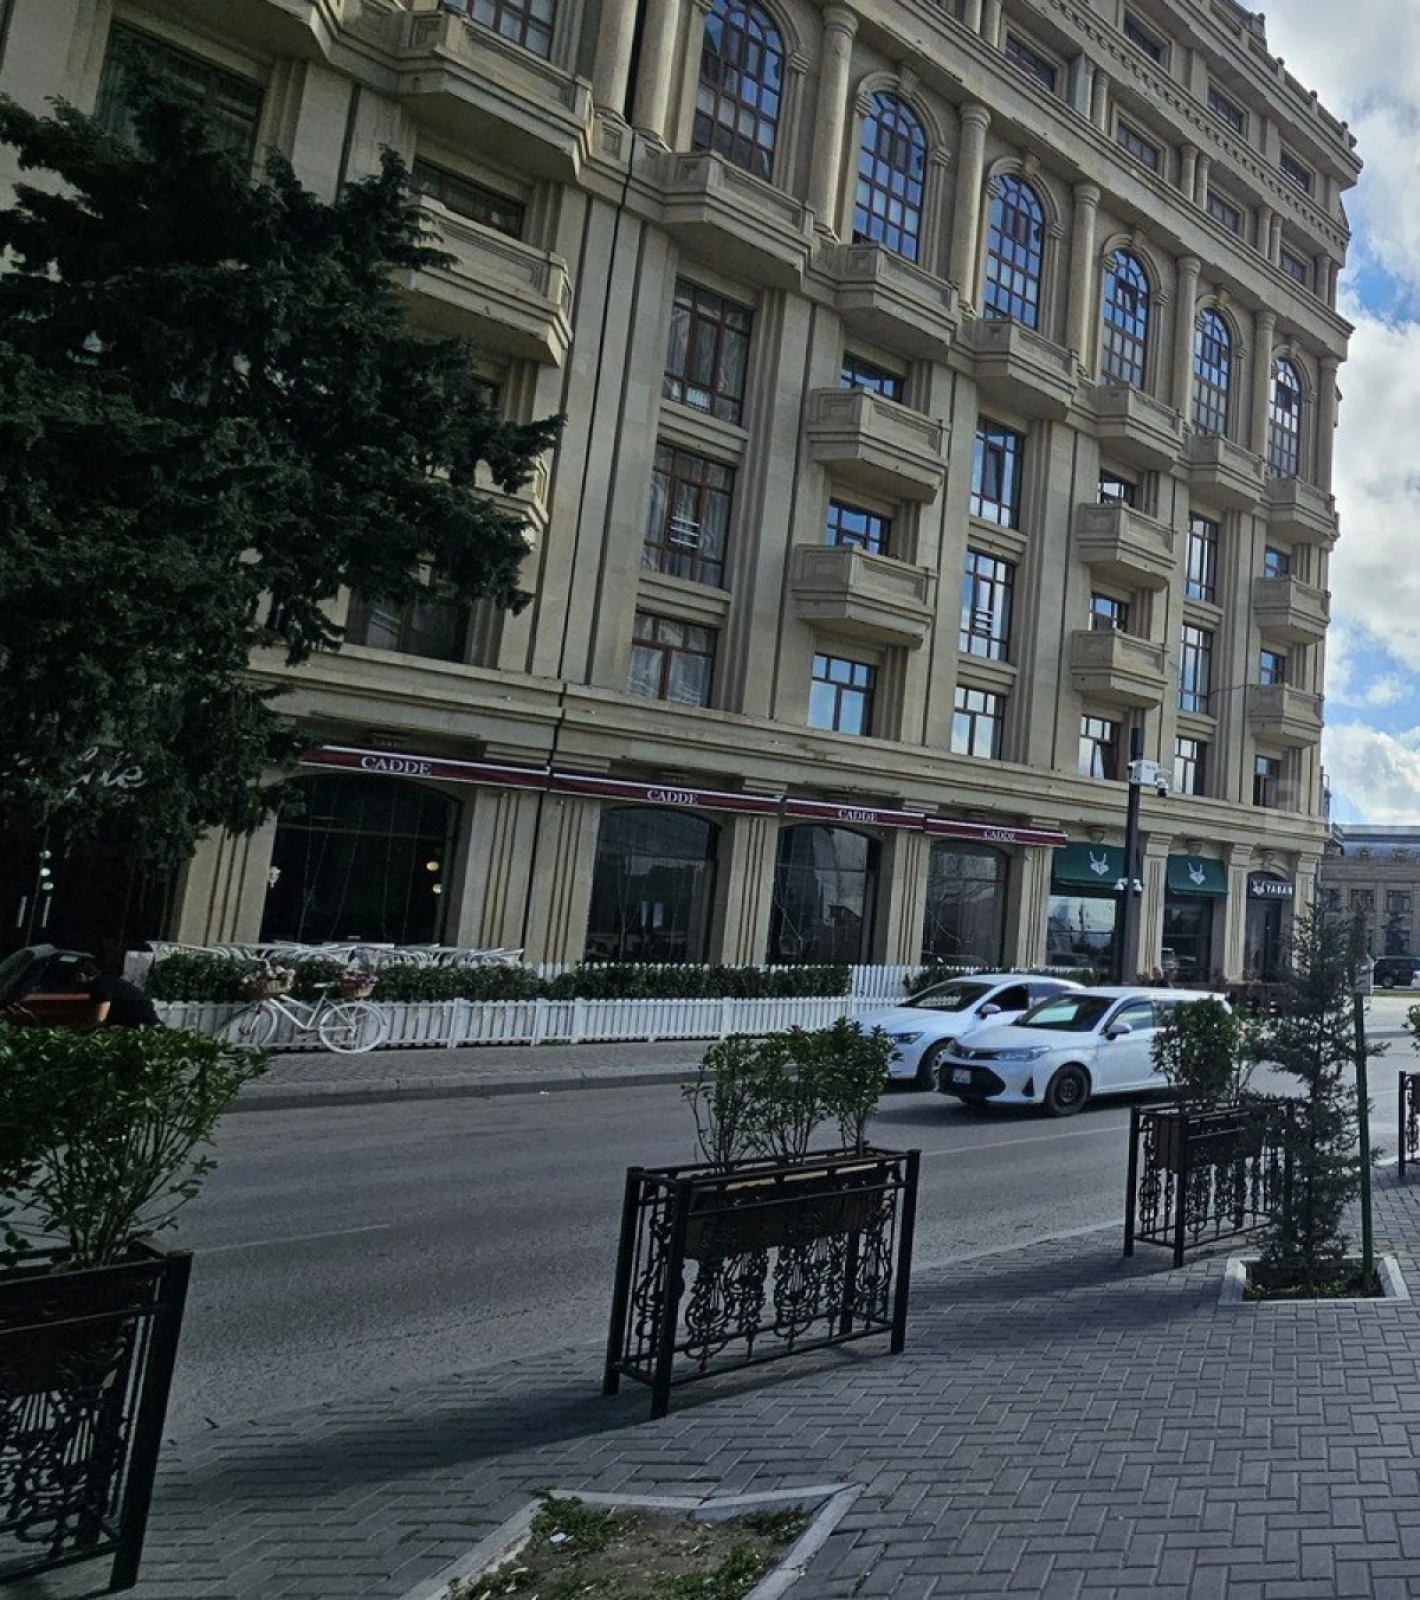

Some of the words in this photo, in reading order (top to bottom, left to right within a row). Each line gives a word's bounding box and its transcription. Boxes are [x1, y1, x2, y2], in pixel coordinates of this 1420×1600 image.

[361, 756, 433, 775] CADDE
[647, 789, 698, 805] CADDE
[838, 809, 878, 821] CADDE
